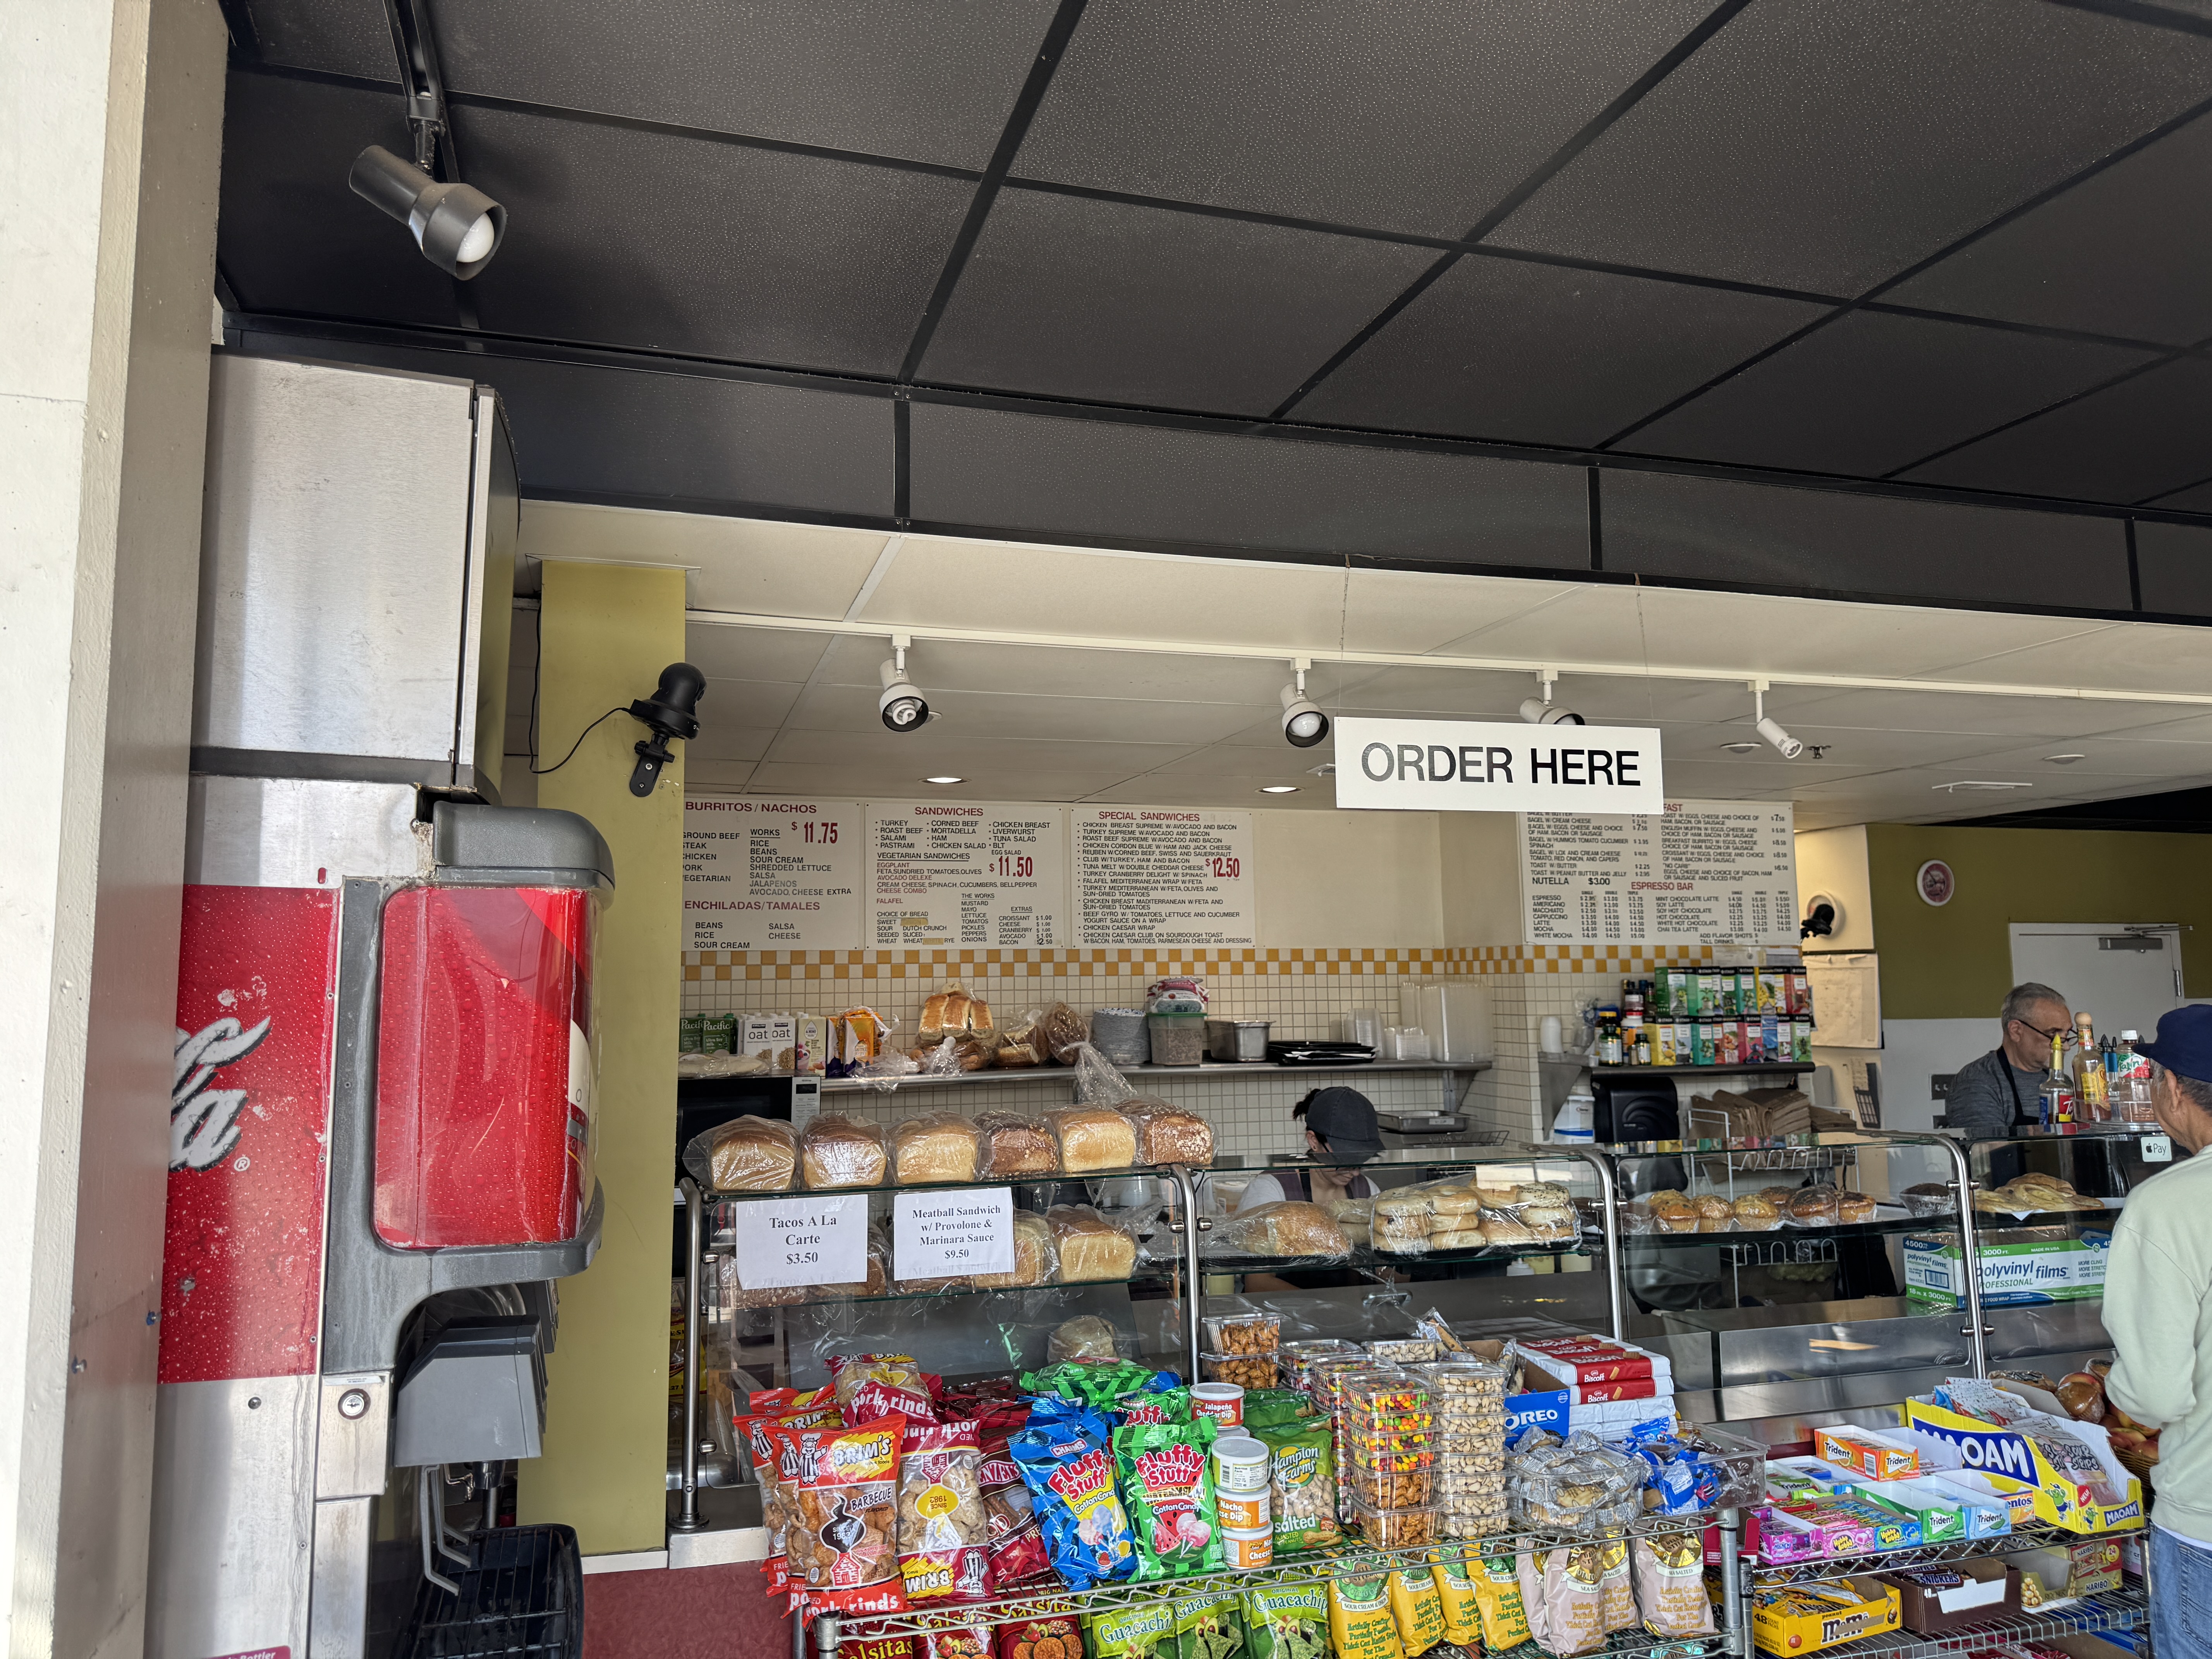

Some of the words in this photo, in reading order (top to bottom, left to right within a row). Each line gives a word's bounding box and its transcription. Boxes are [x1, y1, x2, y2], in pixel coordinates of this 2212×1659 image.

[1362, 742, 1513, 783] ORDER
[1531, 748, 1641, 786] HERE
[686, 802, 752, 811] BURRITOS
[762, 804, 816, 813] NACHOS
[915, 807, 983, 816] SANDWICHES
[1099, 811, 1136, 819] SPECIAL
[1140, 812, 1200, 821] SANDWICHES
[792, 821, 797, 831] $
[804, 822, 838, 843] 11.75
[989, 863, 994, 872] $
[999, 856, 1032, 877] 11.50
[1206, 858, 1210, 867] $
[1631, 882, 1674, 890] ESPRESSO
[703, 1020, 730, 1030] Pacific
[749, 1030, 768, 1039] oat
[773, 1029, 790, 1037] oat
[2154, 1143, 2166, 1155] Pay
[912, 1209, 954, 1219] Meatball
[956, 1206, 1001, 1216] Sandwich
[769, 1218, 804, 1228] Tacos
[808, 1216, 817, 1226] A
[821, 1215, 837, 1226] La
[921, 1223, 932, 1231] w/
[935, 1220, 981, 1231] Provolone
[786, 1234, 820, 1245] Carte
[920, 1236, 964, 1246] Marinara
[967, 1233, 994, 1242] Sauce
[1905, 1240, 1923, 1248] 4500
[786, 1252, 818, 1265] $3.50
[945, 1249, 969, 1259] $9.50
[1907, 1254, 1932, 1262] polyvinyl
[1977, 1261, 2033, 1279] polyvinyl
[2036, 1266, 2066, 1278] films
[1584, 1373, 1605, 1382] Biscoff
[850, 1388, 885, 1413] pork
[891, 1394, 934, 1416] rinds
[1588, 1393, 1608, 1403] Biscoff
[1504, 1410, 1558, 1431] OREO
[833, 1434, 891, 1466] BRIM'S
[1053, 1441, 1085, 1456] CHARMS
[1824, 1442, 1850, 1458] Trident
[2064, 1444, 2092, 1457] SOUR
[1135, 1444, 1206, 1478] Fluffy
[1267, 1447, 1319, 1482] Hampton
[1886, 1456, 1911, 1466] Trident
[2071, 1458, 2100, 1470] STRIPS
[1048, 1449, 1111, 1495] Fluffy
[1148, 1464, 1190, 1487] Stuff
[1278, 1460, 1316, 1491] Farms
[1066, 1468, 1106, 1501] Stuff
[852, 1487, 891, 1511] BARBECUE
[2080, 1488, 2090, 1503] NEU!
[1220, 1500, 1243, 1511] Nacho
[1230, 1512, 1243, 1522] Dip
[1930, 1514, 1954, 1526] Trident
[1977, 1513, 2002, 1523] Trident
[2106, 1504, 2137, 1524] MAOAM
[1274, 1512, 1316, 1533] salted
[833, 1531, 850, 1540] 1982
[2077, 1546, 2093, 1556] HARIBO
[1920, 1574, 1960, 1585] SNICKERS
[2086, 1580, 2108, 1592] HARIBO
[850, 1592, 898, 1612] rinds
[1119, 1613, 1144, 1623] ORIGINAL
[1754, 1613, 1767, 1625] 48
[1822, 1611, 1842, 1619] peanut
